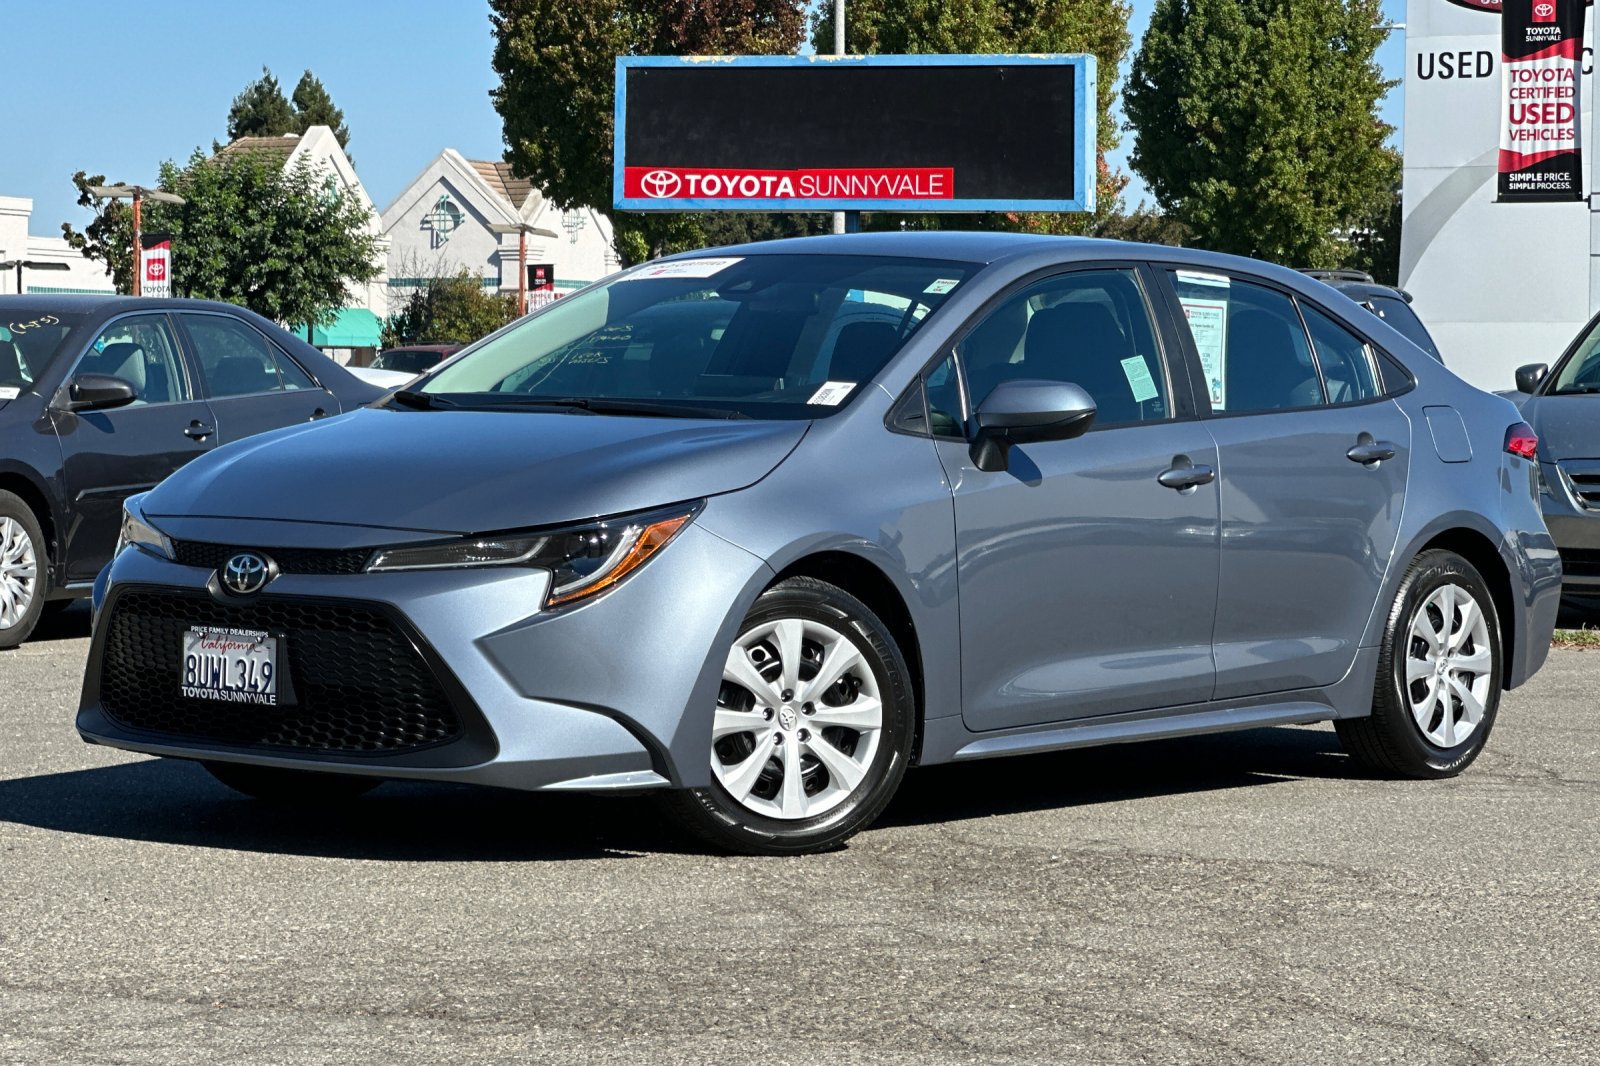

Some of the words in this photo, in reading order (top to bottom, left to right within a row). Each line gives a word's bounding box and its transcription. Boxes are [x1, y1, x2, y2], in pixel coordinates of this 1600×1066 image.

[1525, 26, 1561, 35] TOYOTA
[1417, 51, 1494, 80] USED
[1510, 68, 1575, 82] TOYOTA
[1509, 86, 1576, 99] CERTIFIED
[1509, 103, 1575, 124] USED
[1509, 128, 1575, 141] VEHICLES
[1509, 173, 1543, 181] SIMPLE
[1544, 172, 1572, 181] PRICE.
[685, 174, 796, 198] TOYOTA
[799, 174, 944, 196] SUNNYVALE
[1509, 182, 1536, 190] SIMPLE
[208, 626, 229, 635] FAMILY
[229, 628, 269, 637] DEALERSHIPS
[202, 633, 261, 655] California
[187, 654, 273, 693] 8UWL349
[182, 686, 220, 699] TOYOTA
[220, 690, 276, 705] SUNNYVALE
